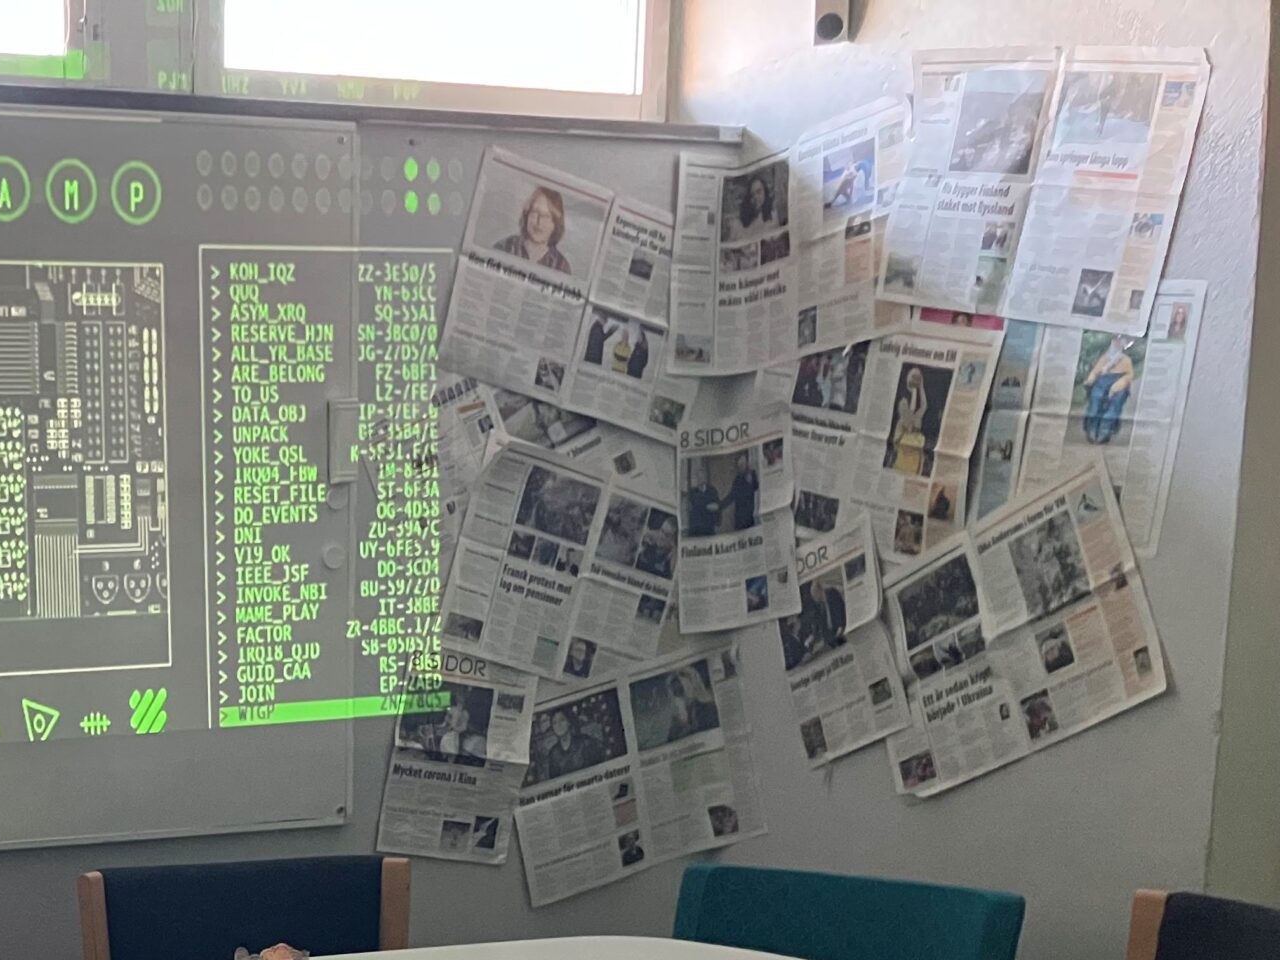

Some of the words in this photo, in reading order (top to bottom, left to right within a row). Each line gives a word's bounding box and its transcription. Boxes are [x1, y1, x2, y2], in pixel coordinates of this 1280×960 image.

[229, 263, 297, 284] KOH_IQZ
[230, 304, 306, 324] ASYM_XRQ
[231, 324, 334, 344] RESERVE_HJN
[231, 345, 334, 364] ALL_YR_BASE
[231, 364, 325, 384] ARE_BELONG
[232, 385, 280, 405] TO_US
[232, 405, 307, 425] DATA_OBJ
[232, 426, 289, 443] UNPACK
[680, 431, 691, 449] 8
[693, 421, 751, 448] SIDOR
[233, 445, 308, 467] YOKE_QSL
[234, 484, 326, 505] RESET_FILE
[234, 504, 319, 526] DO_EVENTS
[234, 527, 262, 545] DNI
[236, 564, 310, 585] IEEE_JSF
[236, 583, 328, 604] INVOKE_NBI
[236, 603, 320, 624] MAME_PLAY
[237, 625, 293, 644] FACTOR
[237, 663, 312, 684] GUID_CAA
[238, 685, 275, 704] JOIN
